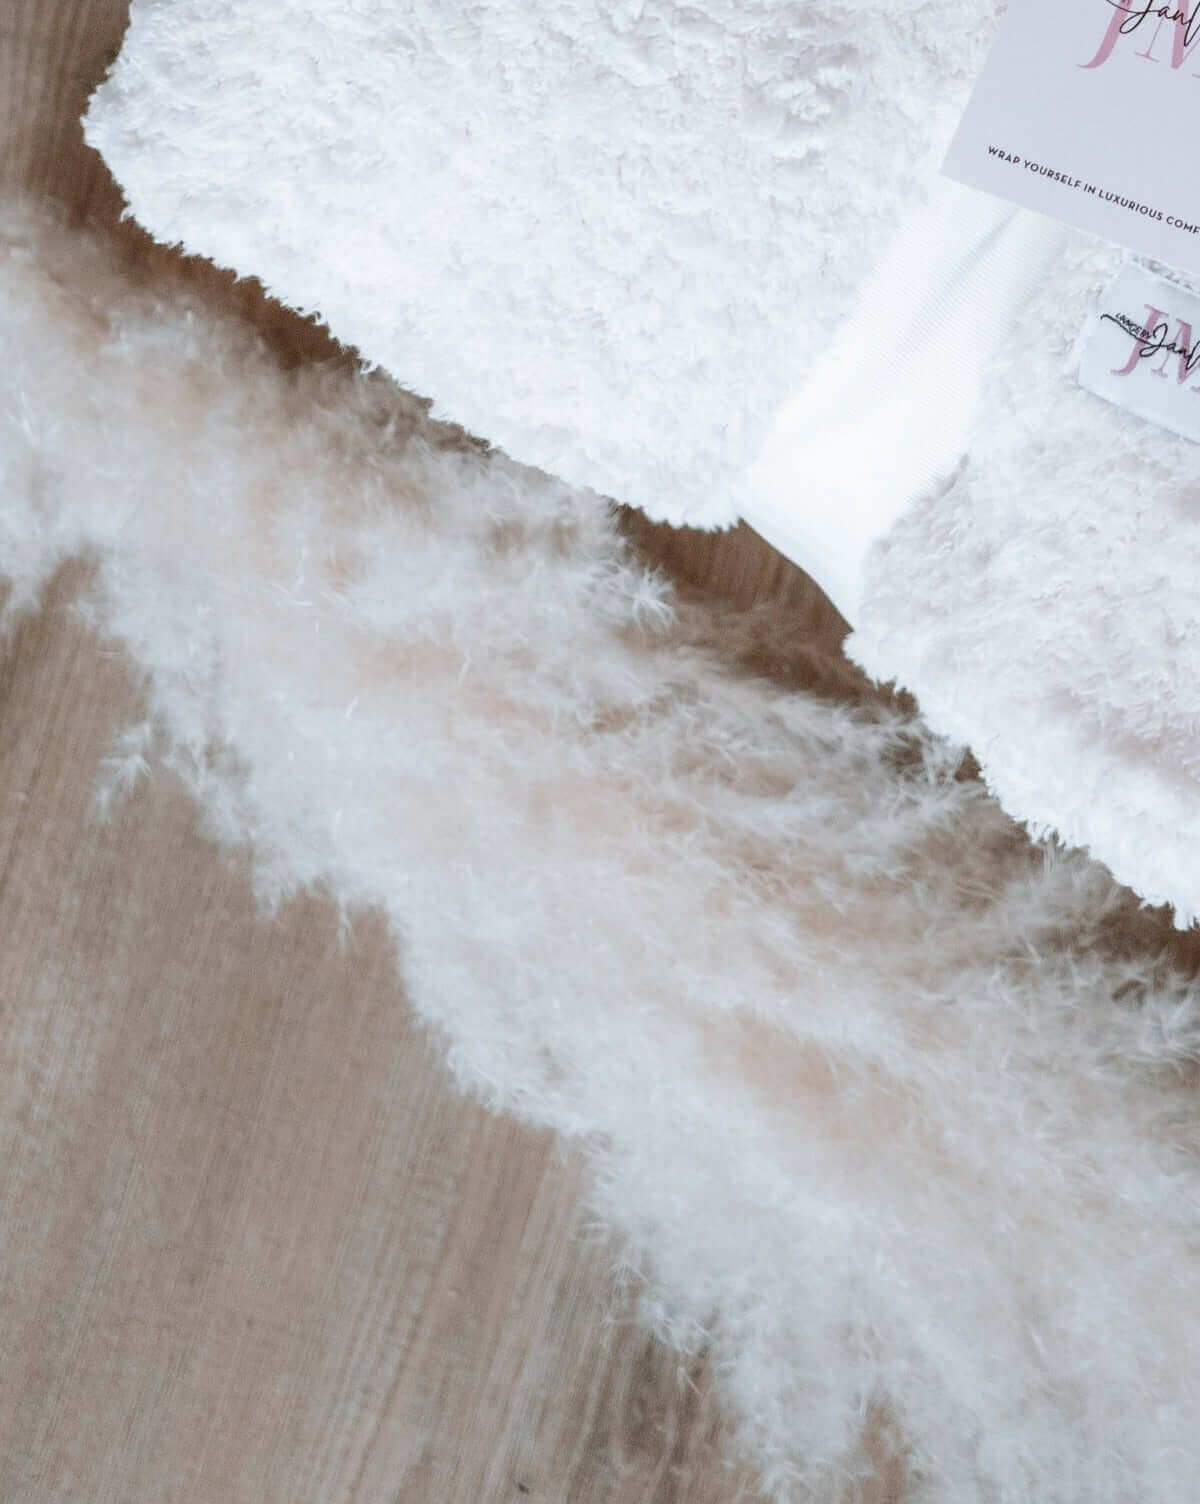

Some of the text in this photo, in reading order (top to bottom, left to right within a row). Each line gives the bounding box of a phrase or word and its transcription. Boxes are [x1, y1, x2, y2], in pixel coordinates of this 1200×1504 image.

[987, 145, 1021, 165] WRAP
[1023, 160, 1082, 189] YOURSELF
[1083, 182, 1097, 195] IN
[1098, 189, 1164, 222] LUXURIOUS
